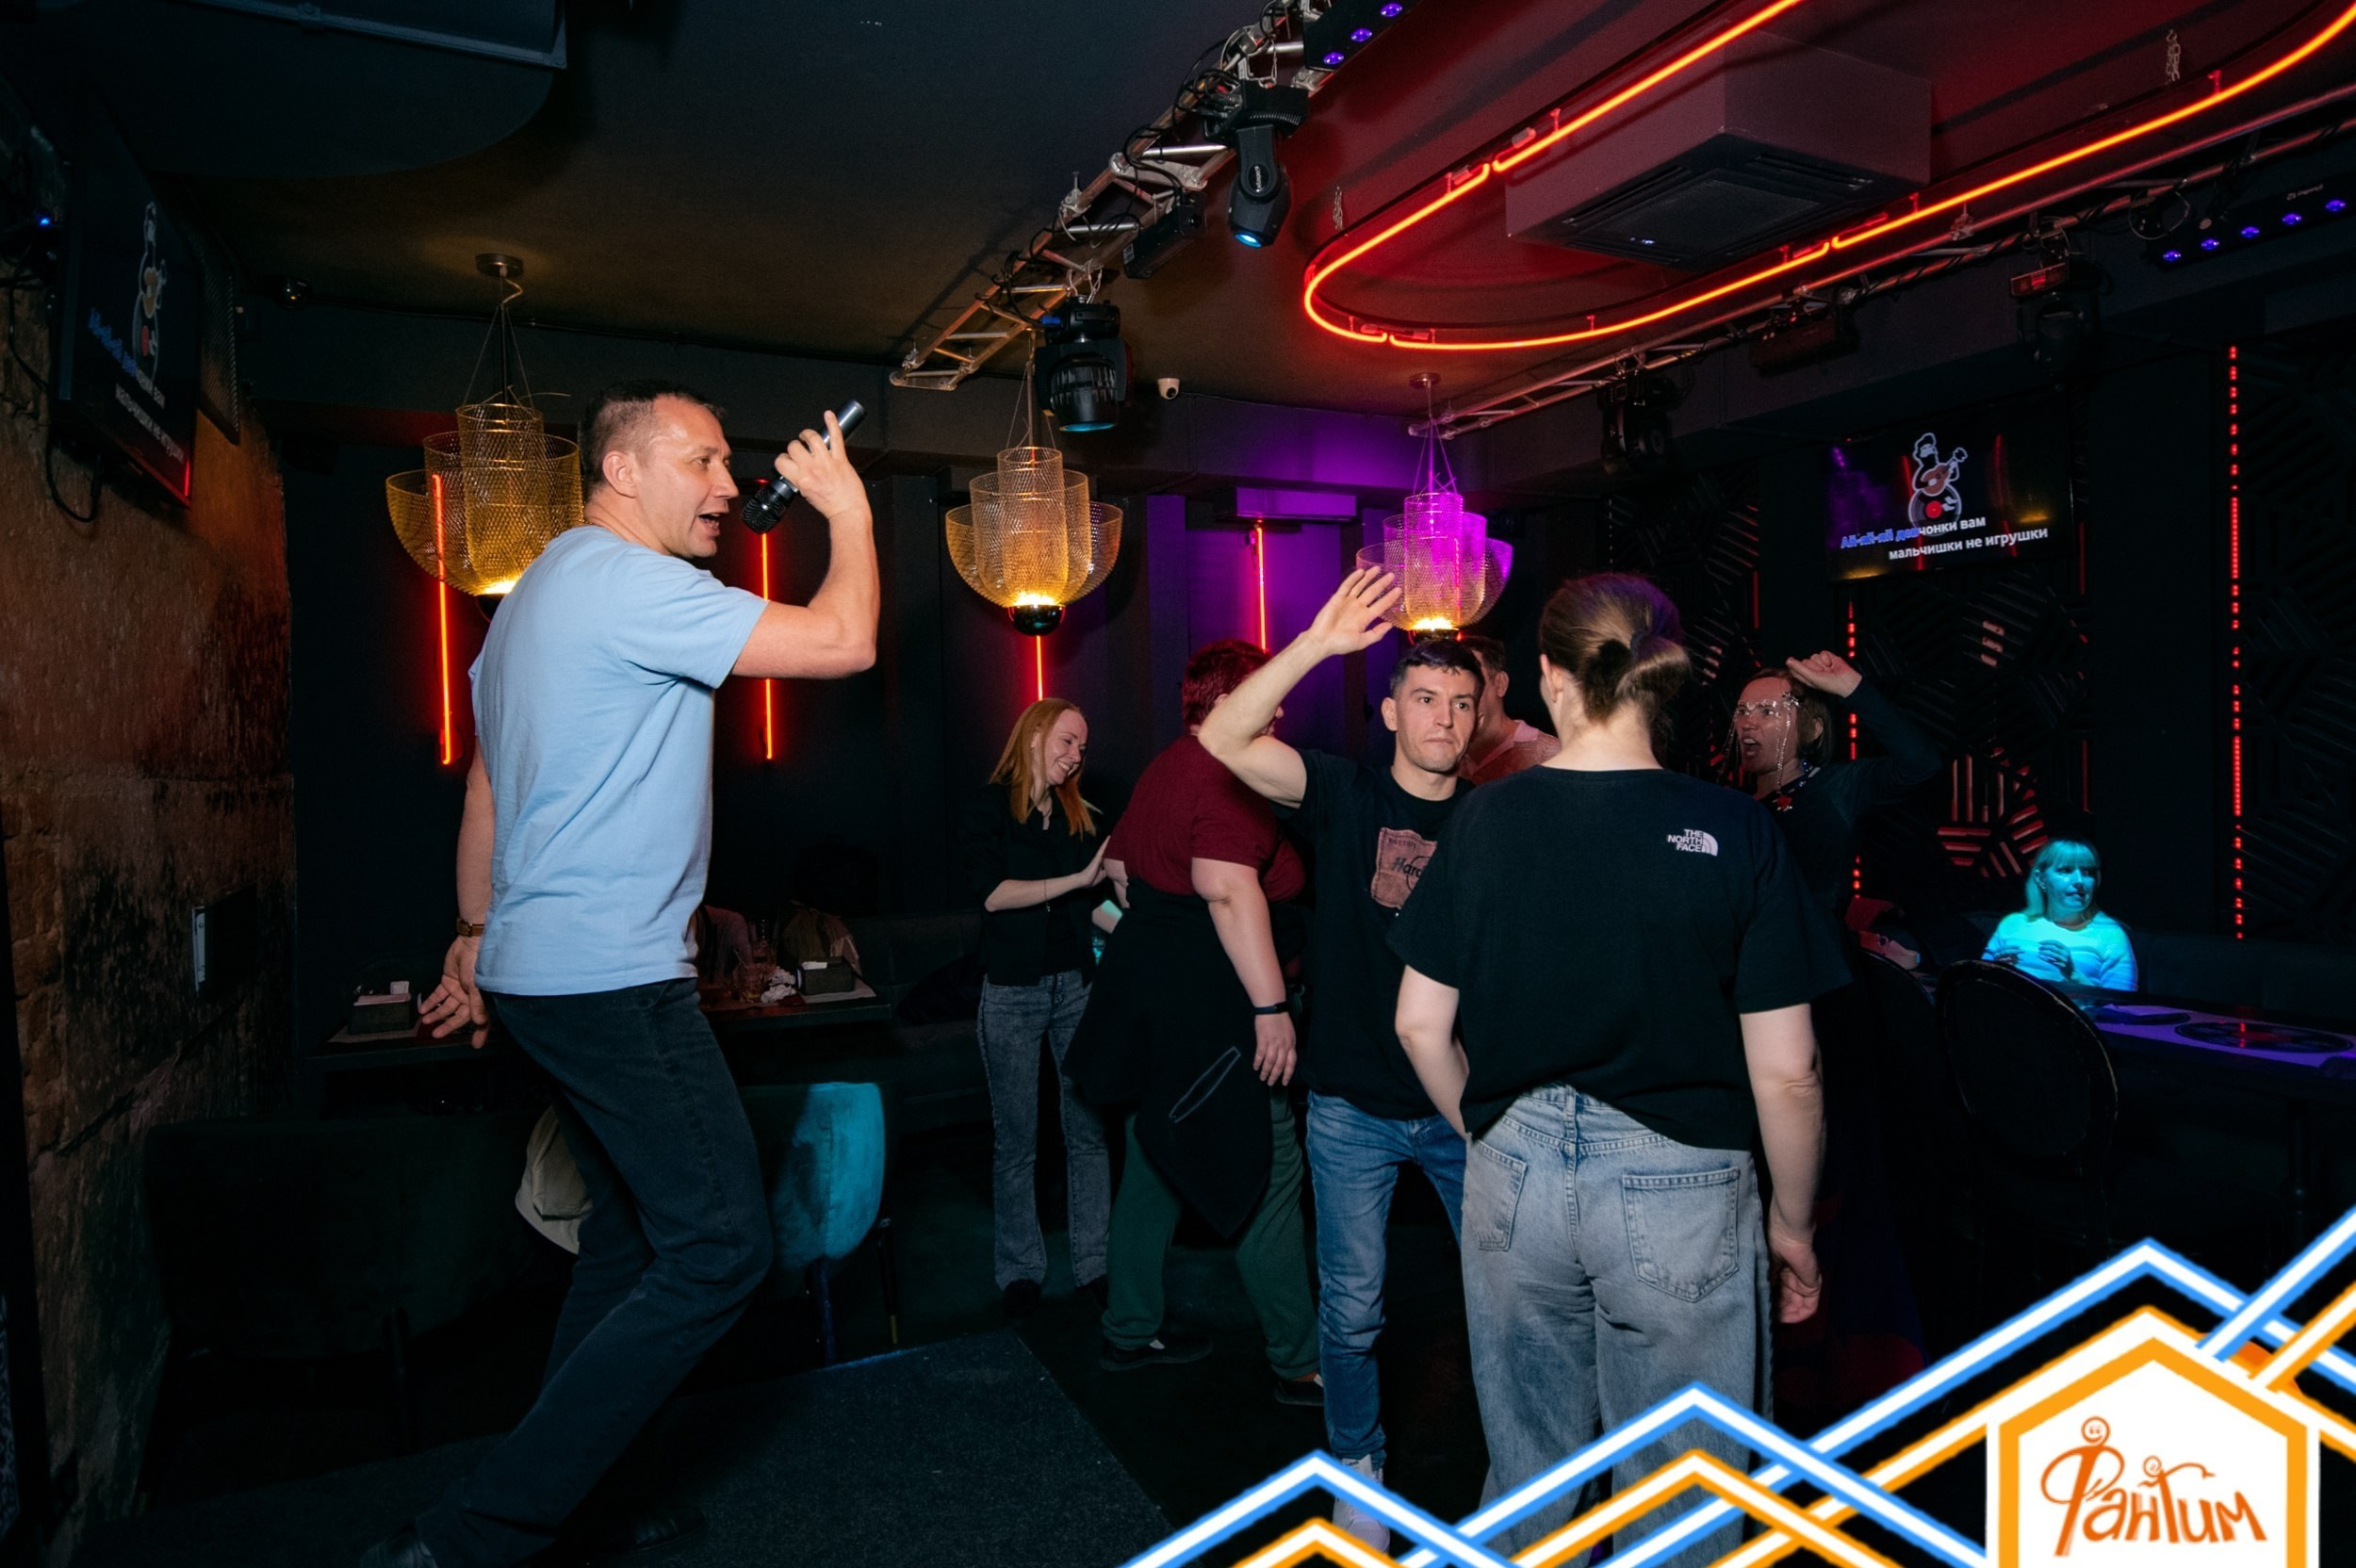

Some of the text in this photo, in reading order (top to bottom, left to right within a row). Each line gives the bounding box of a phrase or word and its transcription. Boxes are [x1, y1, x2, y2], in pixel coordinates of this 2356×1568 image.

[1895, 520, 1957, 542] девчонки
[1960, 516, 1986, 530] вам
[1889, 528, 2048, 560] мальчишки не игрушки
[1684, 828, 1703, 838] THE
[1667, 834, 1703, 845] NORTH
[1677, 842, 1701, 852] FACE
